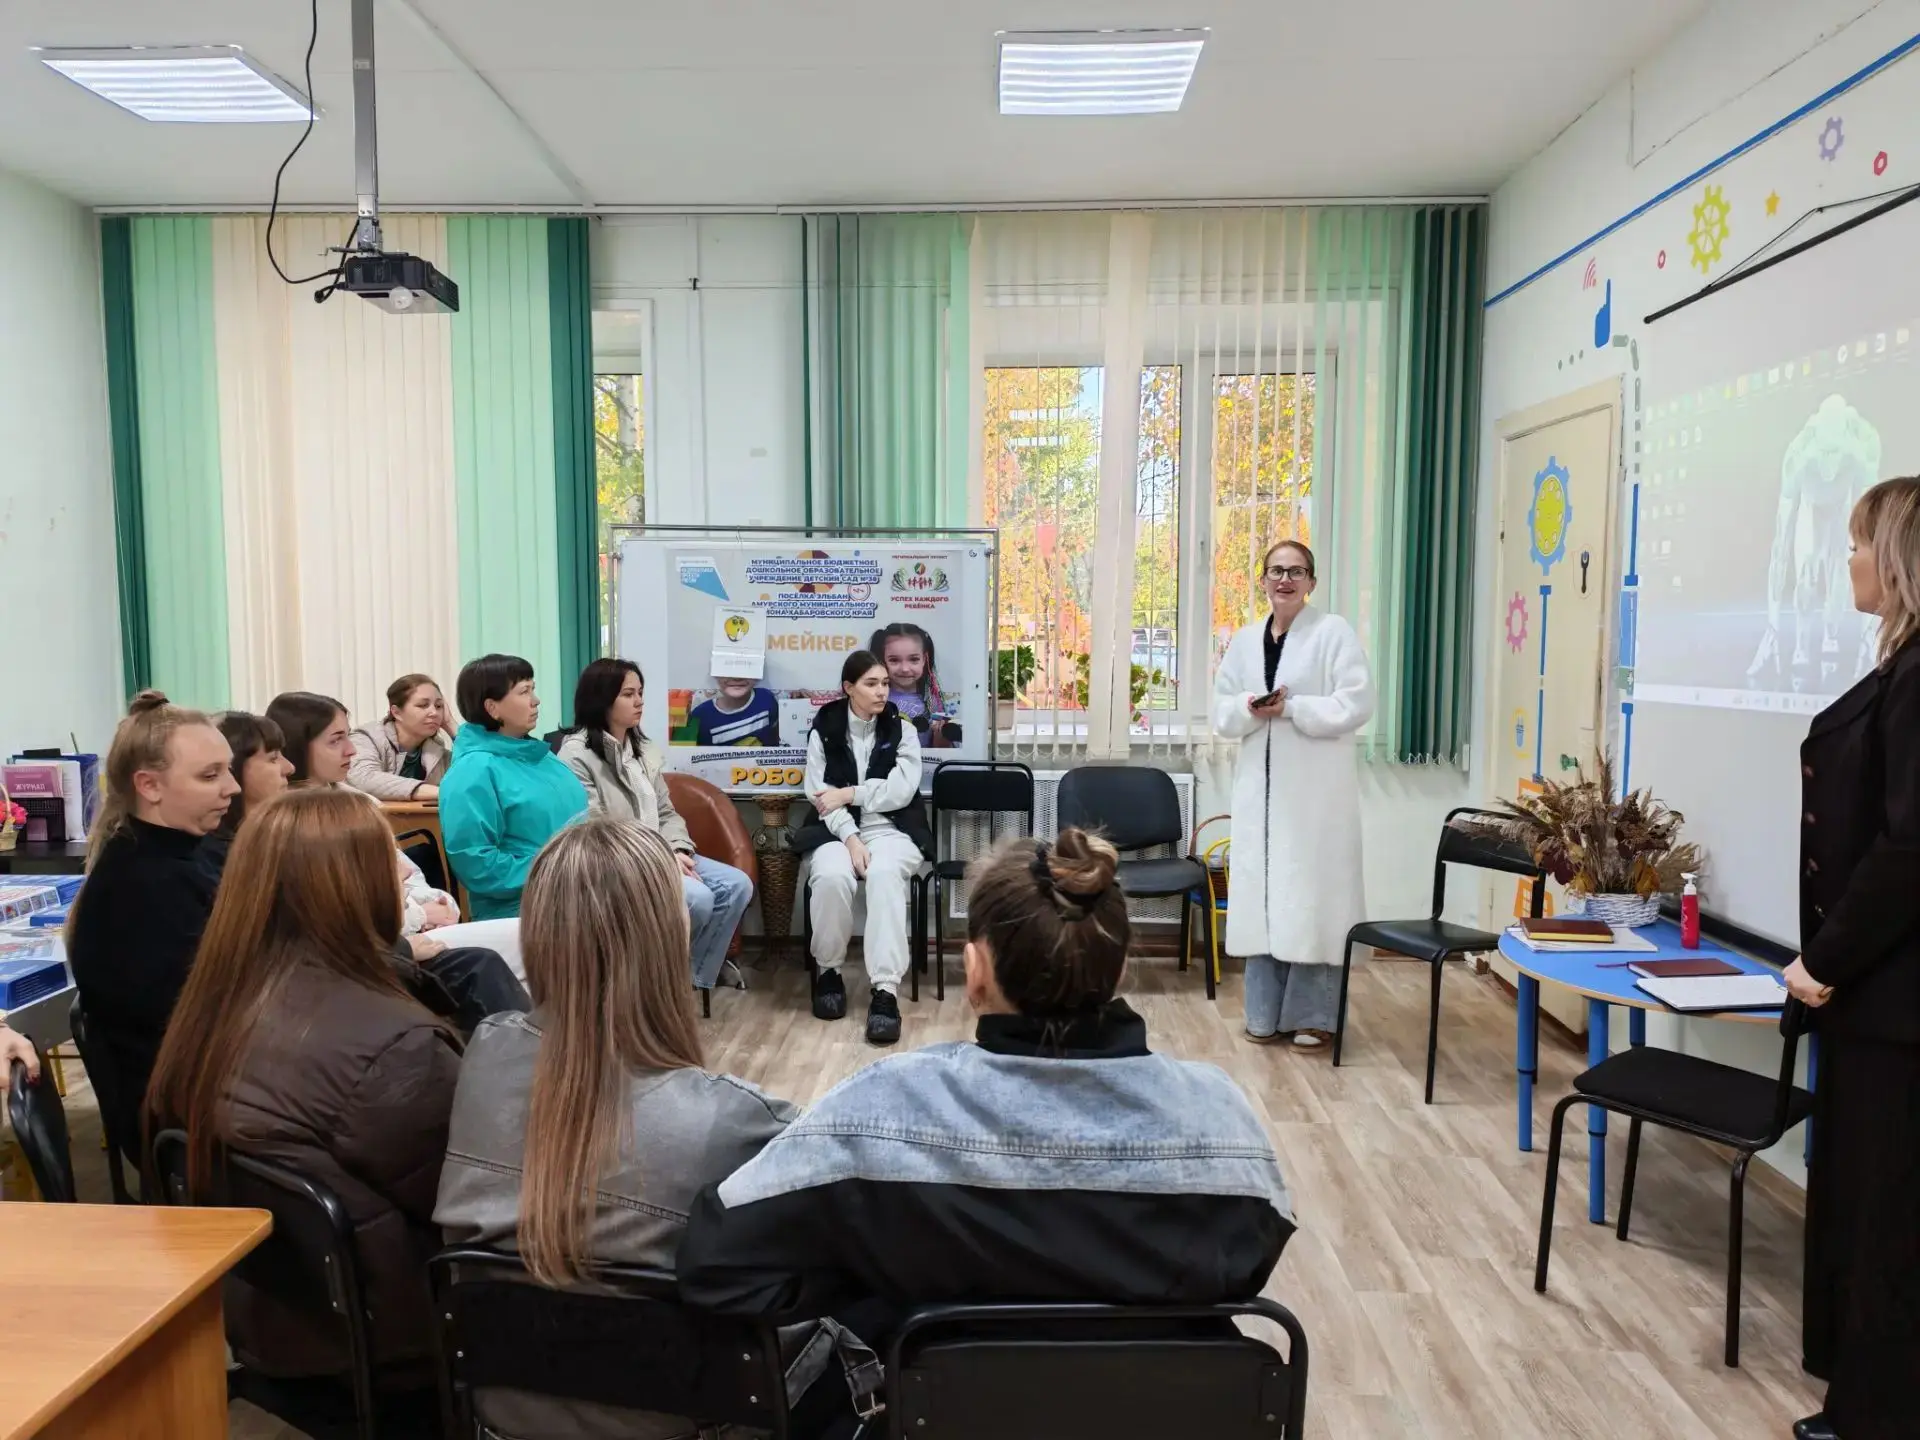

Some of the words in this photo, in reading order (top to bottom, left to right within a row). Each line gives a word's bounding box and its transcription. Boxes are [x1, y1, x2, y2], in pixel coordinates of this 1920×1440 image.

[767, 630, 858, 651] МЕЙКЕР
[691, 751, 755, 761] ДОПОЛНИТЕЛЬНАЯ
[731, 767, 803, 786] РОБО
